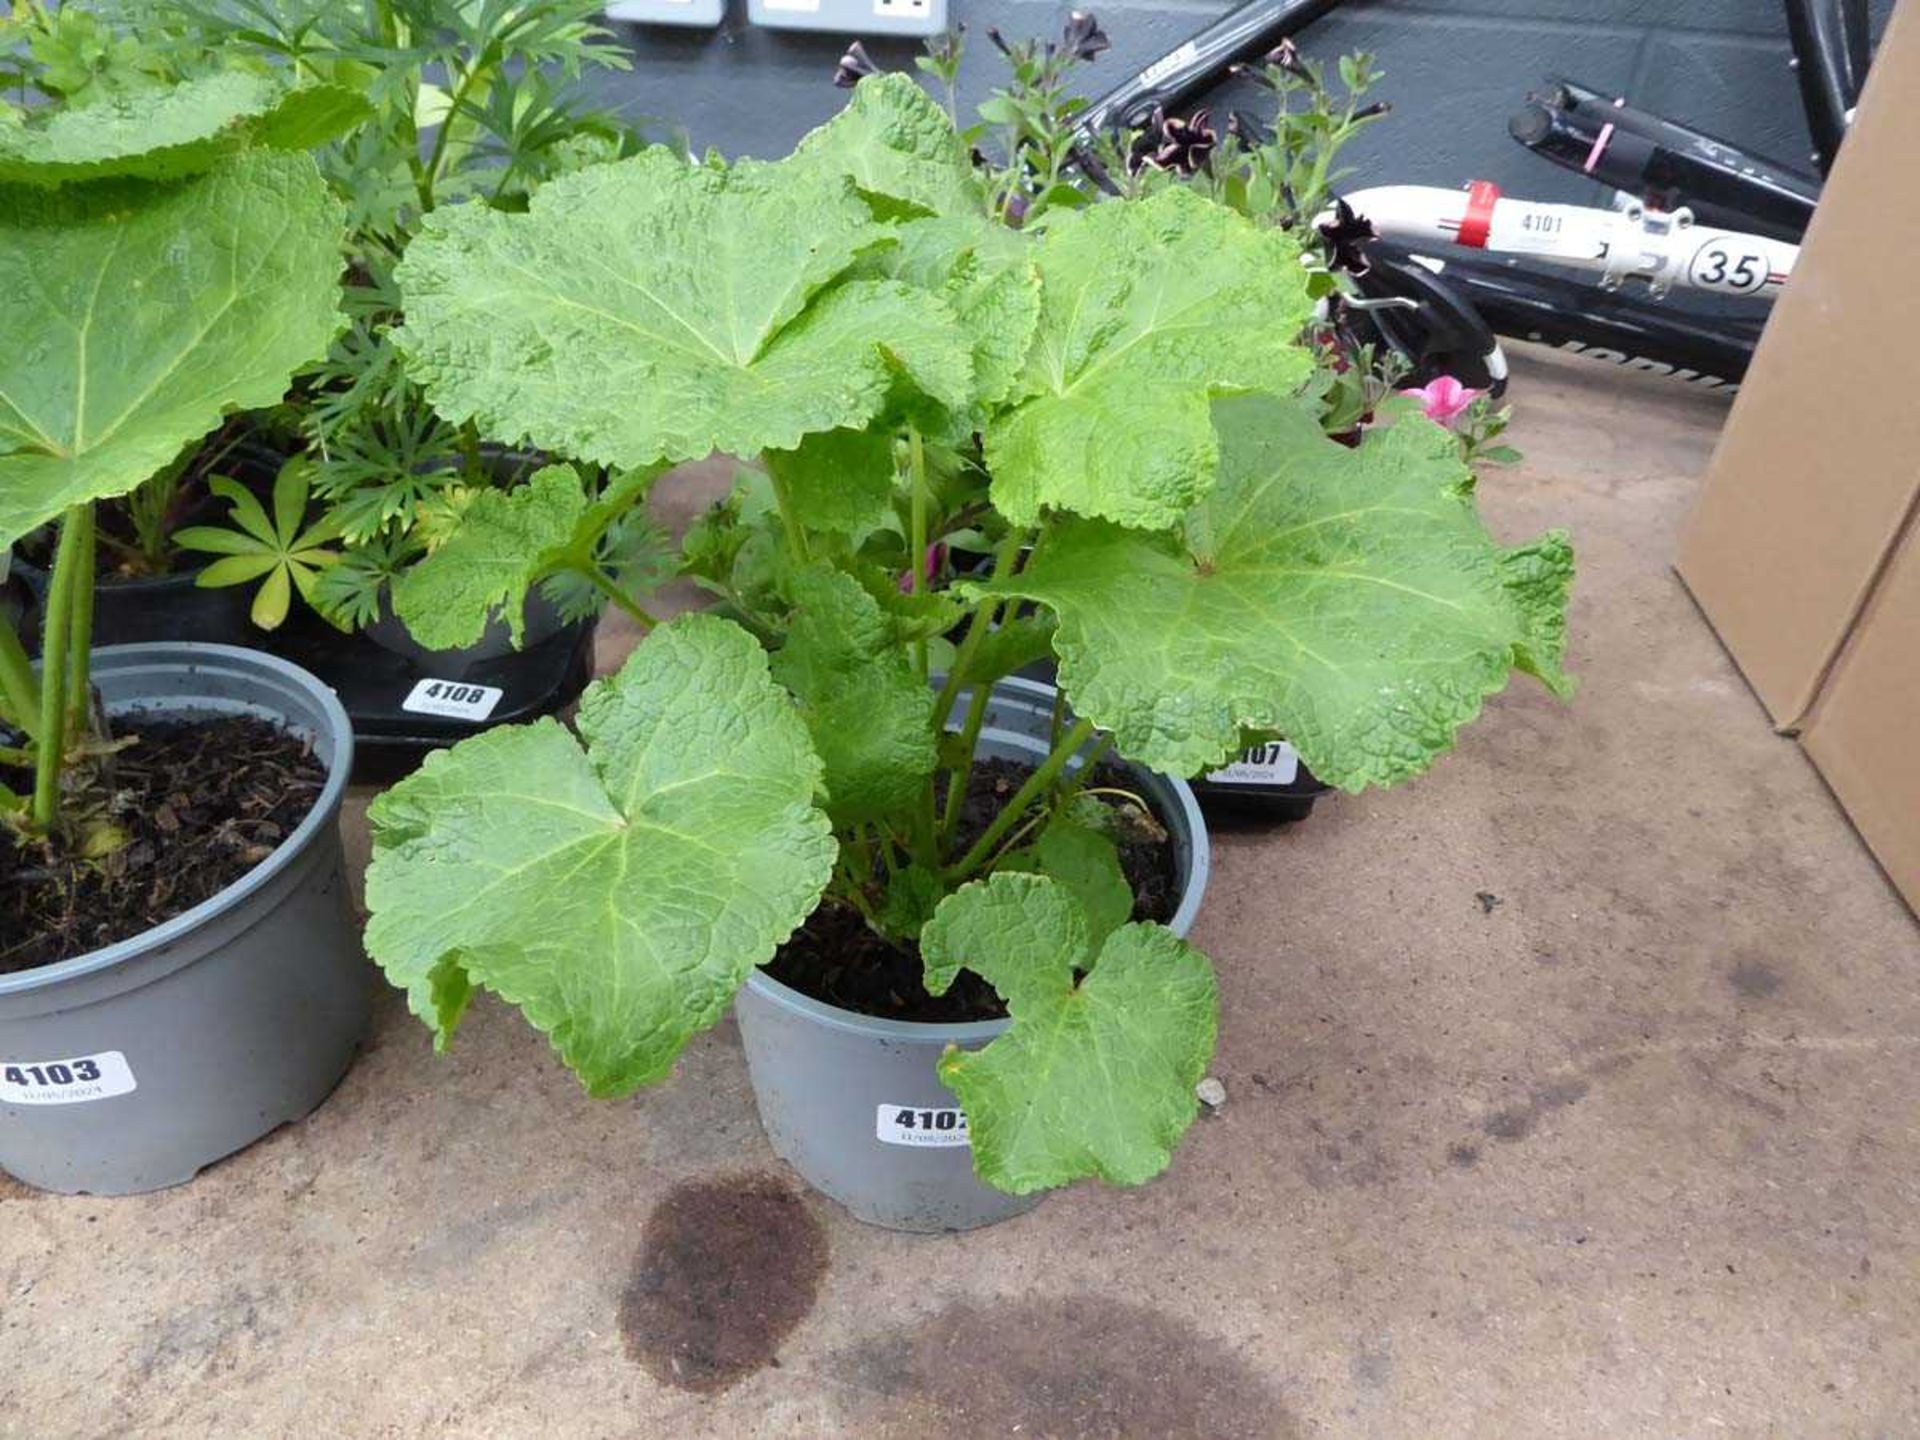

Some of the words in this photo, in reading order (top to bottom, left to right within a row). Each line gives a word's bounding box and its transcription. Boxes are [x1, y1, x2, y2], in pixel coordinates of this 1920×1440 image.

[1522, 214, 1562, 232] 4101
[1699, 250, 1759, 287] 35
[425, 682, 485, 704] 4108
[1240, 744, 1281, 765] 107
[5, 1060, 101, 1086] 4103
